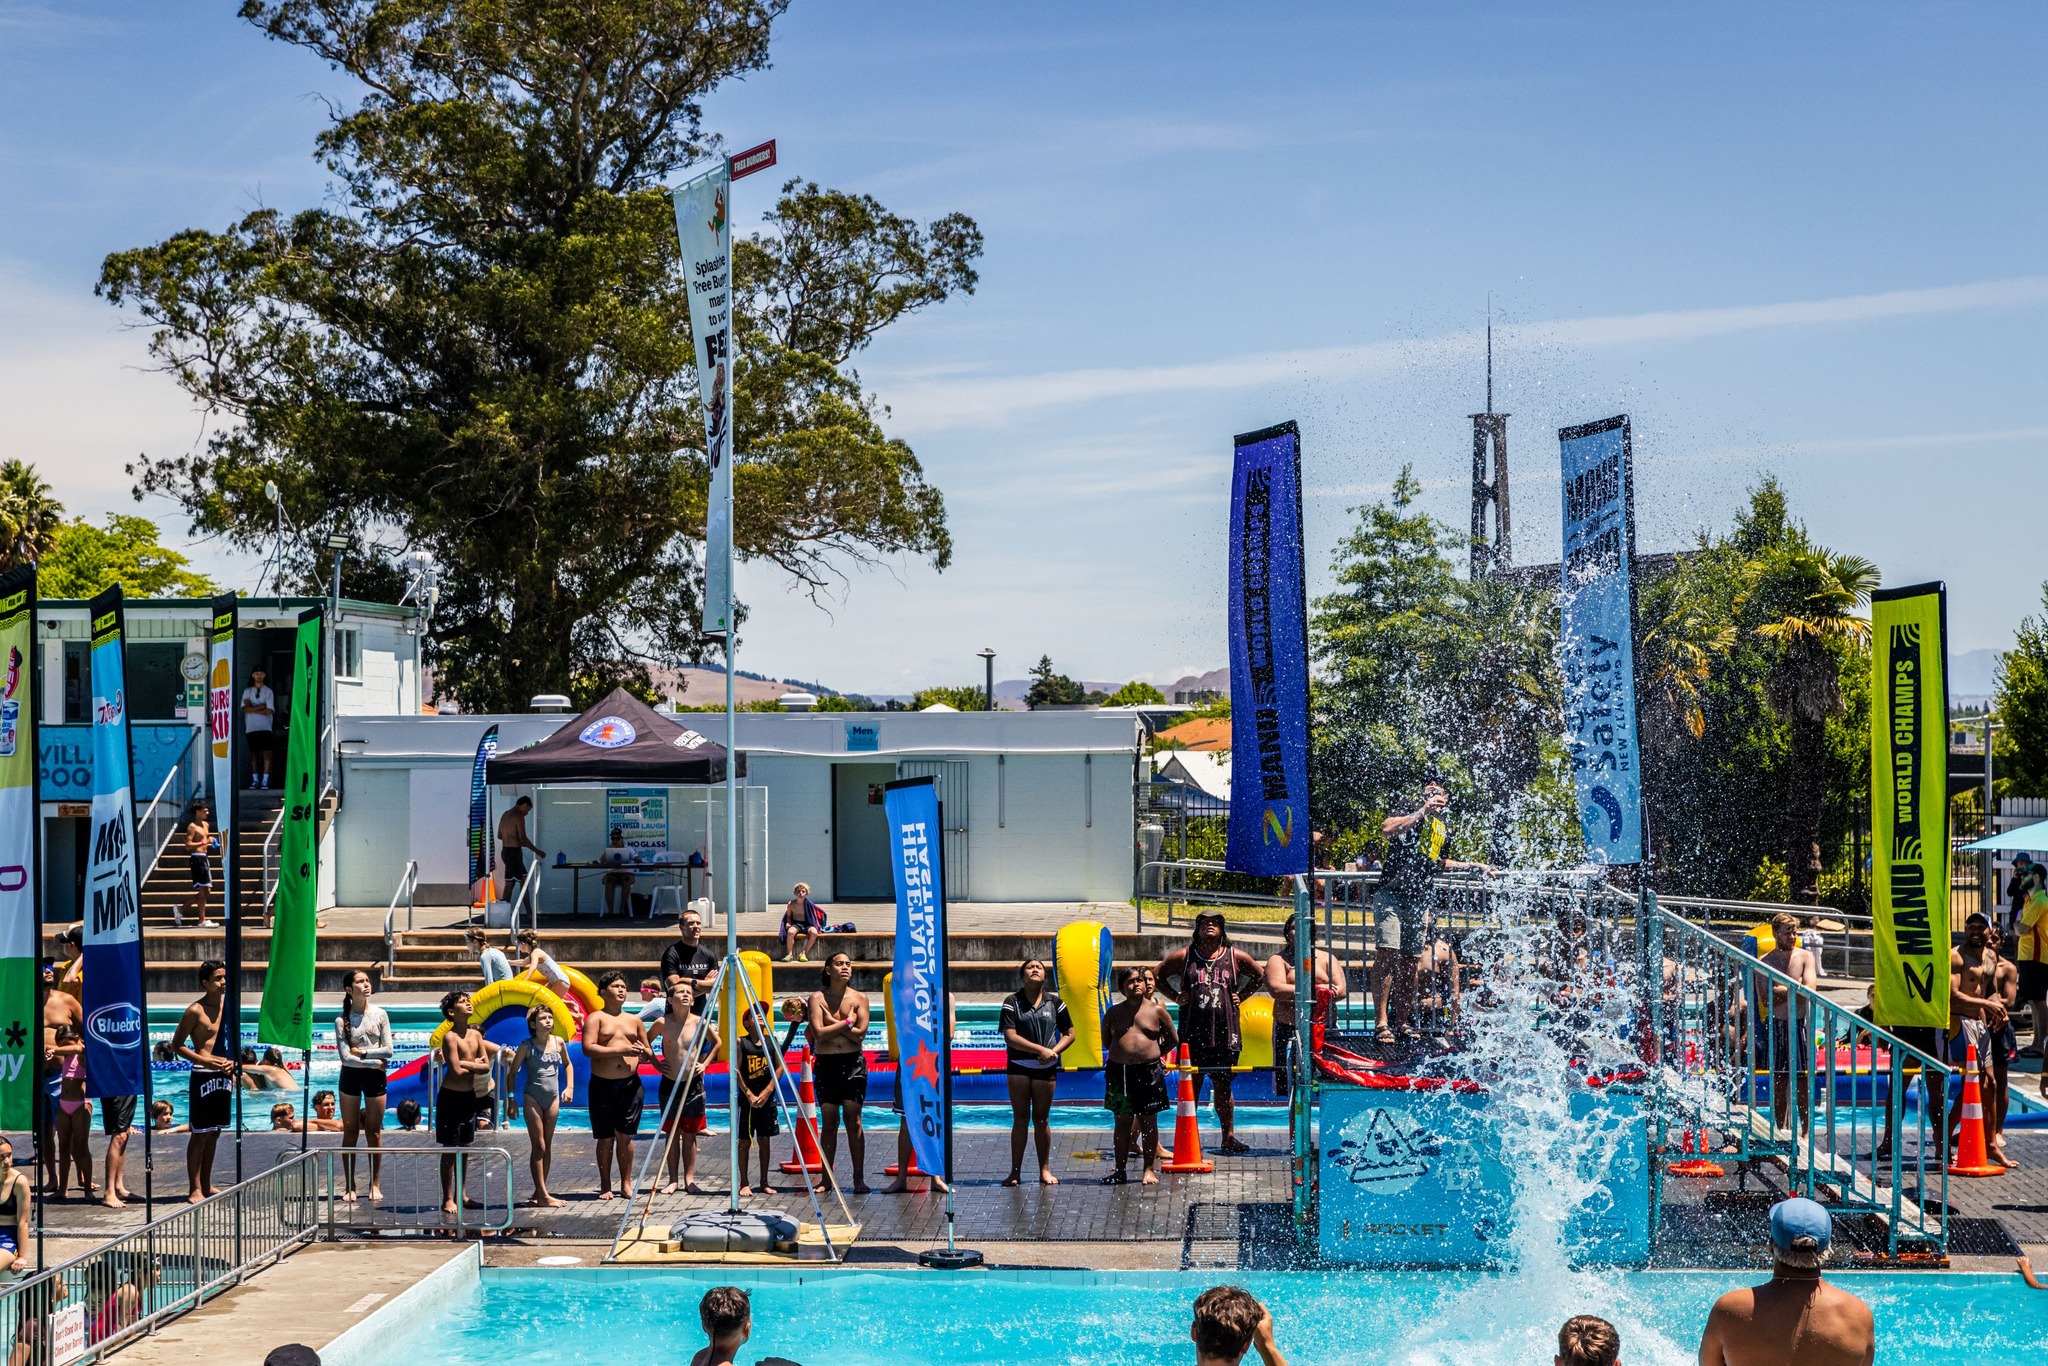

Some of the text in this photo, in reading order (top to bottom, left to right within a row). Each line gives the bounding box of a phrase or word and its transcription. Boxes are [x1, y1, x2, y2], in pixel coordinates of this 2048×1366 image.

[734, 149, 771, 172] FREE BURGERS!
[1248, 503, 1265, 589] CHAMPS
[1250, 596, 1268, 668] WORLD
[1895, 660, 1914, 746] CHAMPS
[852, 726, 874, 735] Men
[1255, 708, 1289, 800] MANU
[609, 805, 640, 814] CHILDREN
[1898, 753, 1913, 824] WORLD
[643, 809, 664, 819] POOL
[1890, 864, 1934, 956] MANU
[747, 1056, 769, 1074] HEA
[1362, 1222, 1449, 1236] ROCKET
